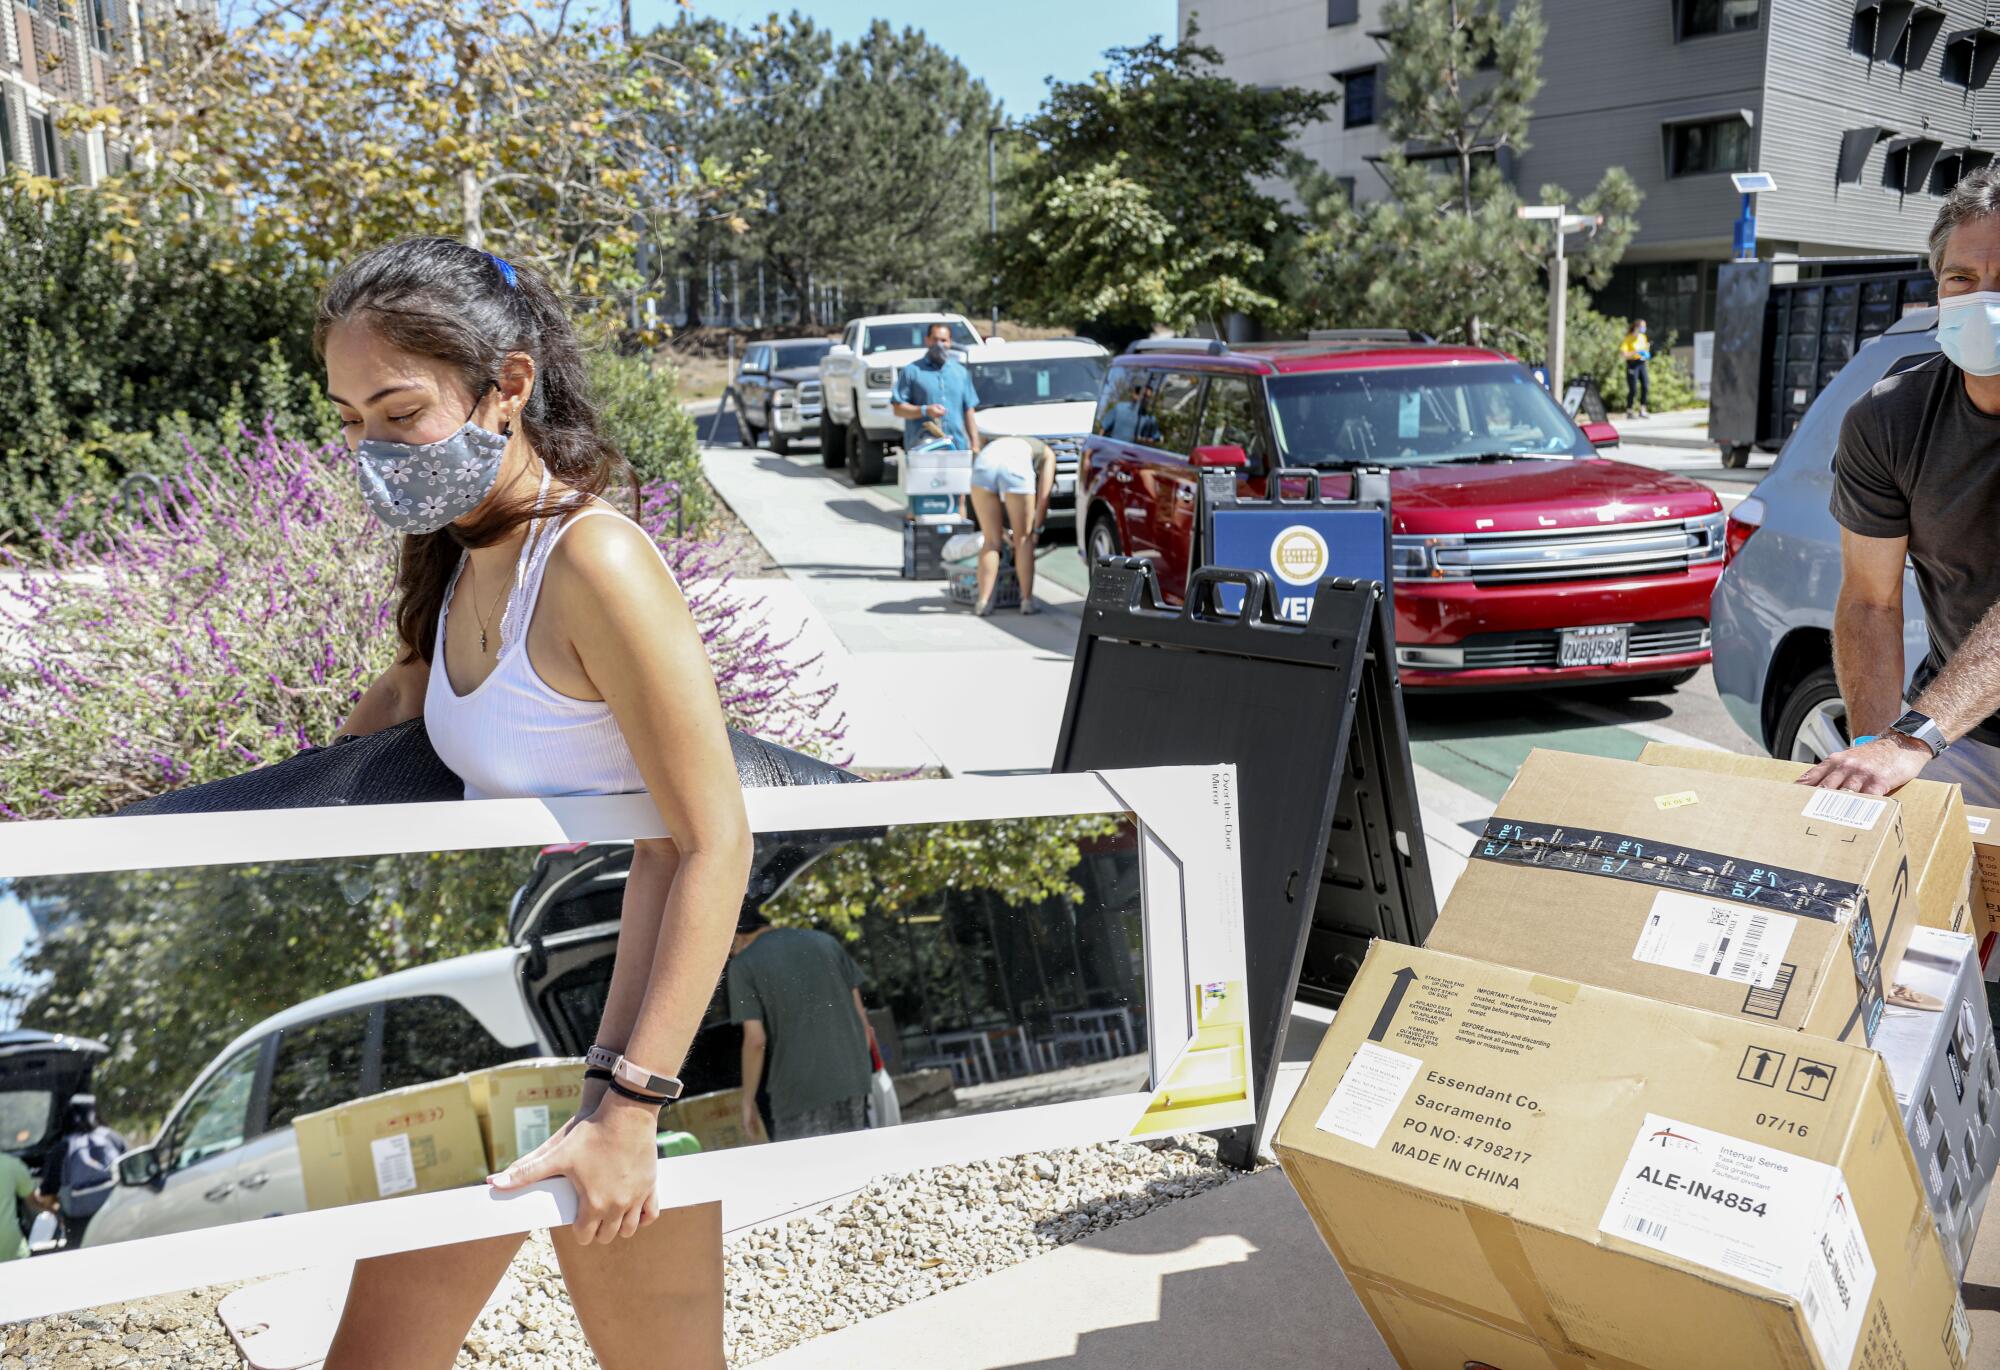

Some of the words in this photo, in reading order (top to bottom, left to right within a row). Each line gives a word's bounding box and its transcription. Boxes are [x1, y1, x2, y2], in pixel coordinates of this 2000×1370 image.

[1212, 773, 1220, 805] Mirror
[1222, 773, 1232, 850] Over-the-Door
[1484, 824, 1512, 856] prme
[1409, 1004, 1433, 1012] EXTREMO
[1415, 1000, 1437, 1008] APILADO
[1471, 1001, 1491, 1011] damage
[1492, 1006, 1509, 1014] before
[1510, 1010, 1530, 1020] signing
[1530, 1016, 1552, 1025] delivery
[1500, 1001, 1520, 1010] inspect
[1529, 1008, 1557, 1018] concealed
[1515, 997, 1532, 1005] carton
[1414, 1016, 1438, 1025] COSTADO
[1455, 1035, 1476, 1044] damage
[1483, 1042, 1504, 1052] missing
[1462, 1022, 1484, 1031] BEFORE
[1485, 1028, 1509, 1038] assembly
[1522, 1036, 1551, 1048] discarding
[1477, 1033, 1493, 1041] check
[1501, 1039, 1524, 1049] contents
[1426, 1070, 1513, 1104] Essendant
[1515, 1095, 1542, 1112] Co.
[1415, 1094, 1512, 1131] Sacramento
[1756, 1113, 1809, 1137] 07/16
[1402, 1118, 1427, 1133] PO
[1430, 1126, 1460, 1144] NO:
[1464, 1136, 1532, 1164] 4798217
[1391, 1141, 1441, 1166] MADE
[1442, 1157, 1462, 1172] IN
[1465, 1164, 1520, 1190] CHINA
[1715, 1162, 1729, 1171] Silla
[1730, 1167, 1760, 1180] giratoria
[1718, 1154, 1734, 1164] Task
[1736, 1160, 1753, 1169] chair
[1720, 1146, 1756, 1163] Interval
[1758, 1158, 1789, 1173] Series
[1636, 1166, 1768, 1218] ALE-IN4854
[1712, 1169, 1739, 1182] Fauteuil
[1741, 1178, 1771, 1191] pivotant
